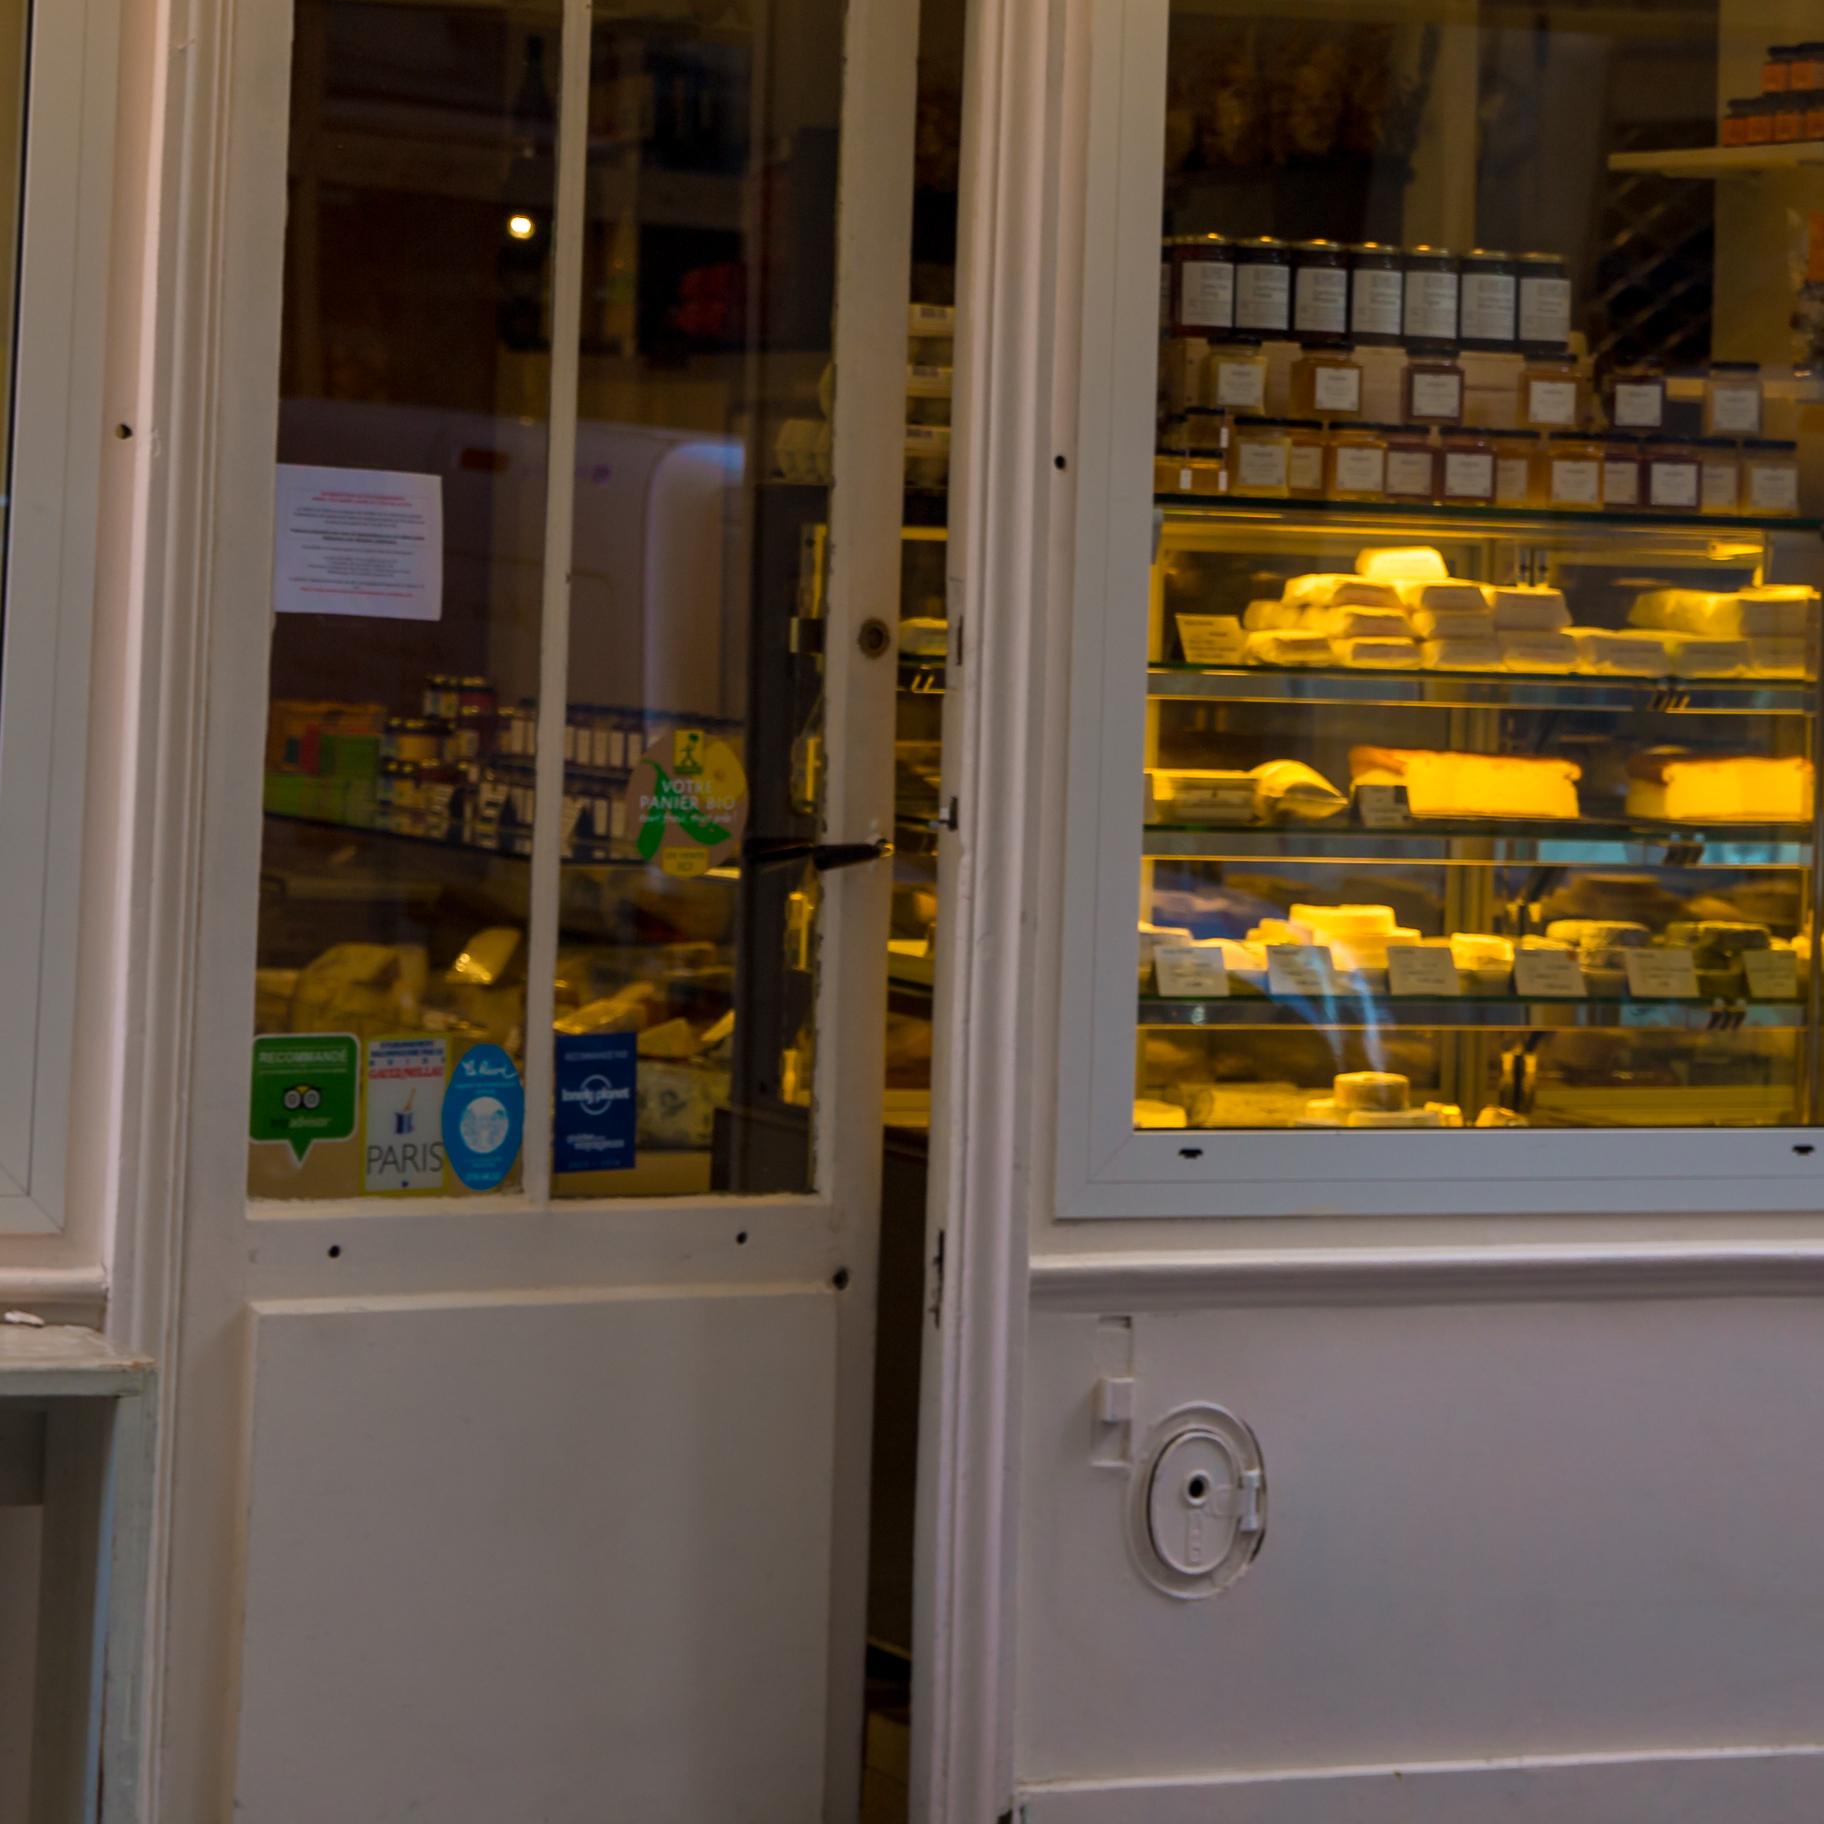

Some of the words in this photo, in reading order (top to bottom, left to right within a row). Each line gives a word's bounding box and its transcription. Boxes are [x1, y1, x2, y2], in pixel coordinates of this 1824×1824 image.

[663, 779, 712, 795] VOTRE
[639, 796, 700, 810] PANIER
[706, 797, 735, 811] BIO
[367, 1141, 443, 1175] PARIS
